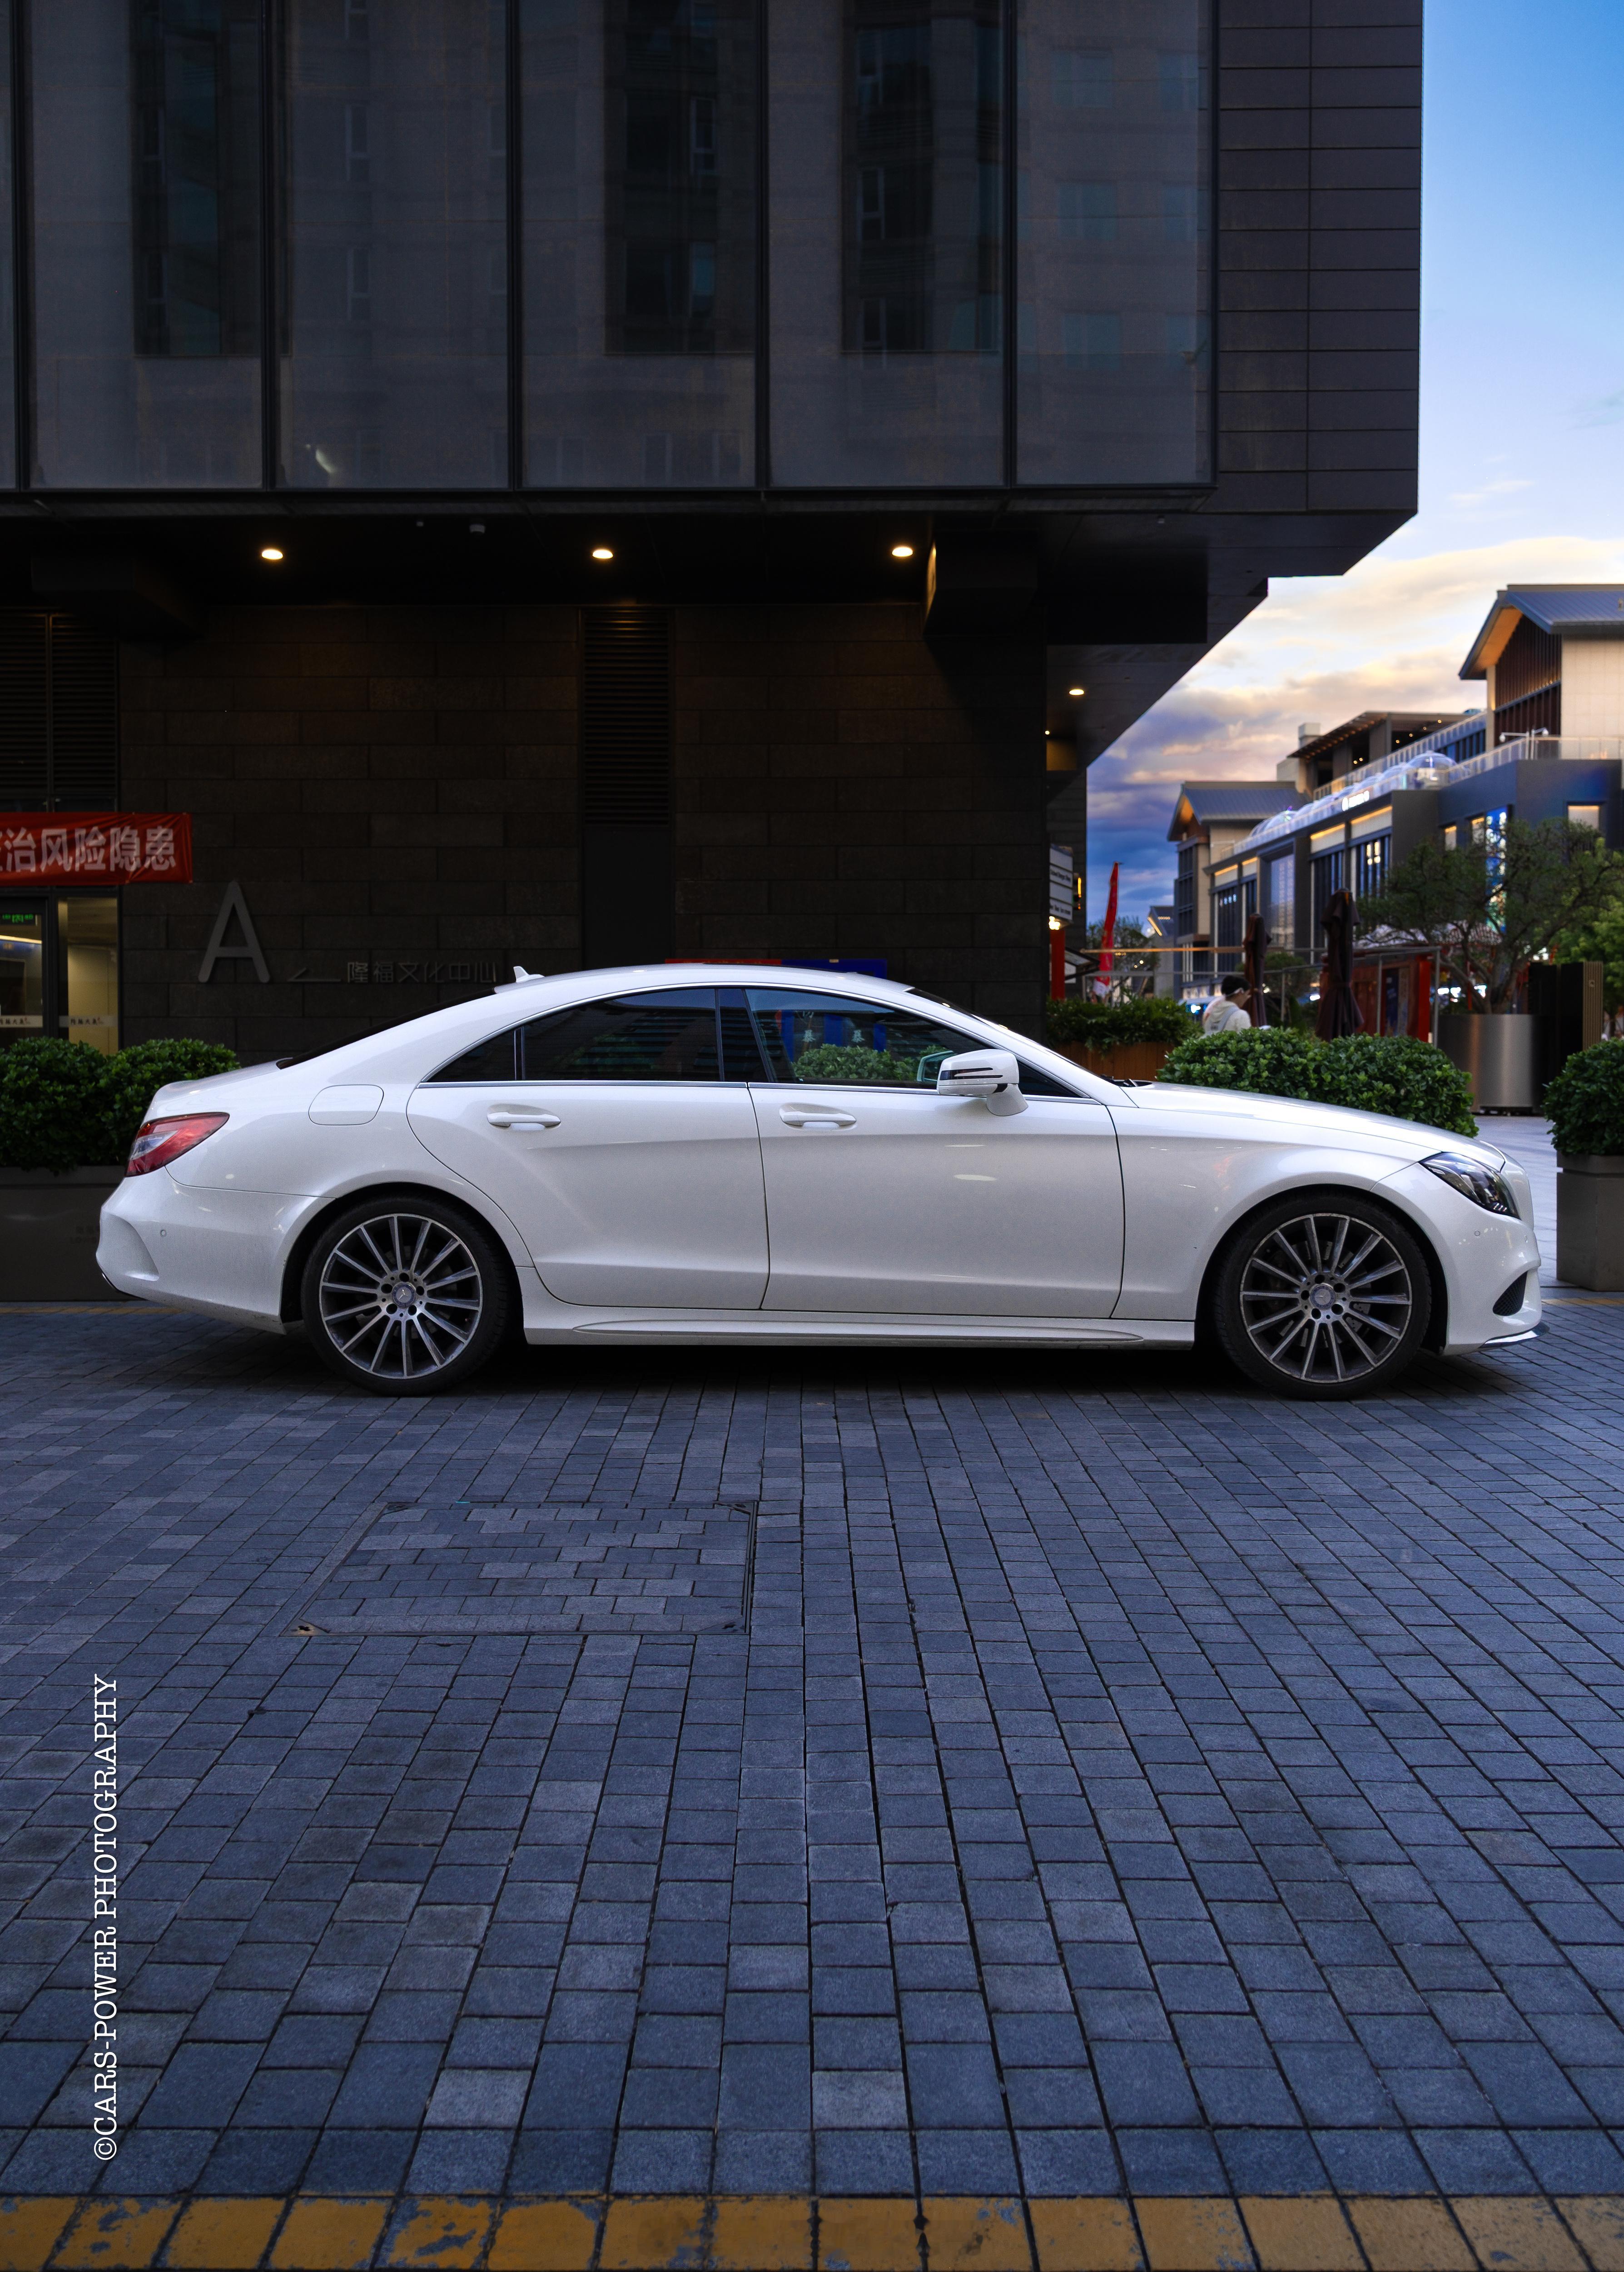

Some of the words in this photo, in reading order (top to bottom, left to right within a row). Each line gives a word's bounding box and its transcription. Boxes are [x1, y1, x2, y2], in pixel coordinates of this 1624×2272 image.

[0, 826, 176, 873] 治风险隐患
[198, 881, 270, 983] A
[347, 962, 497, 983] 隆福文化中心
